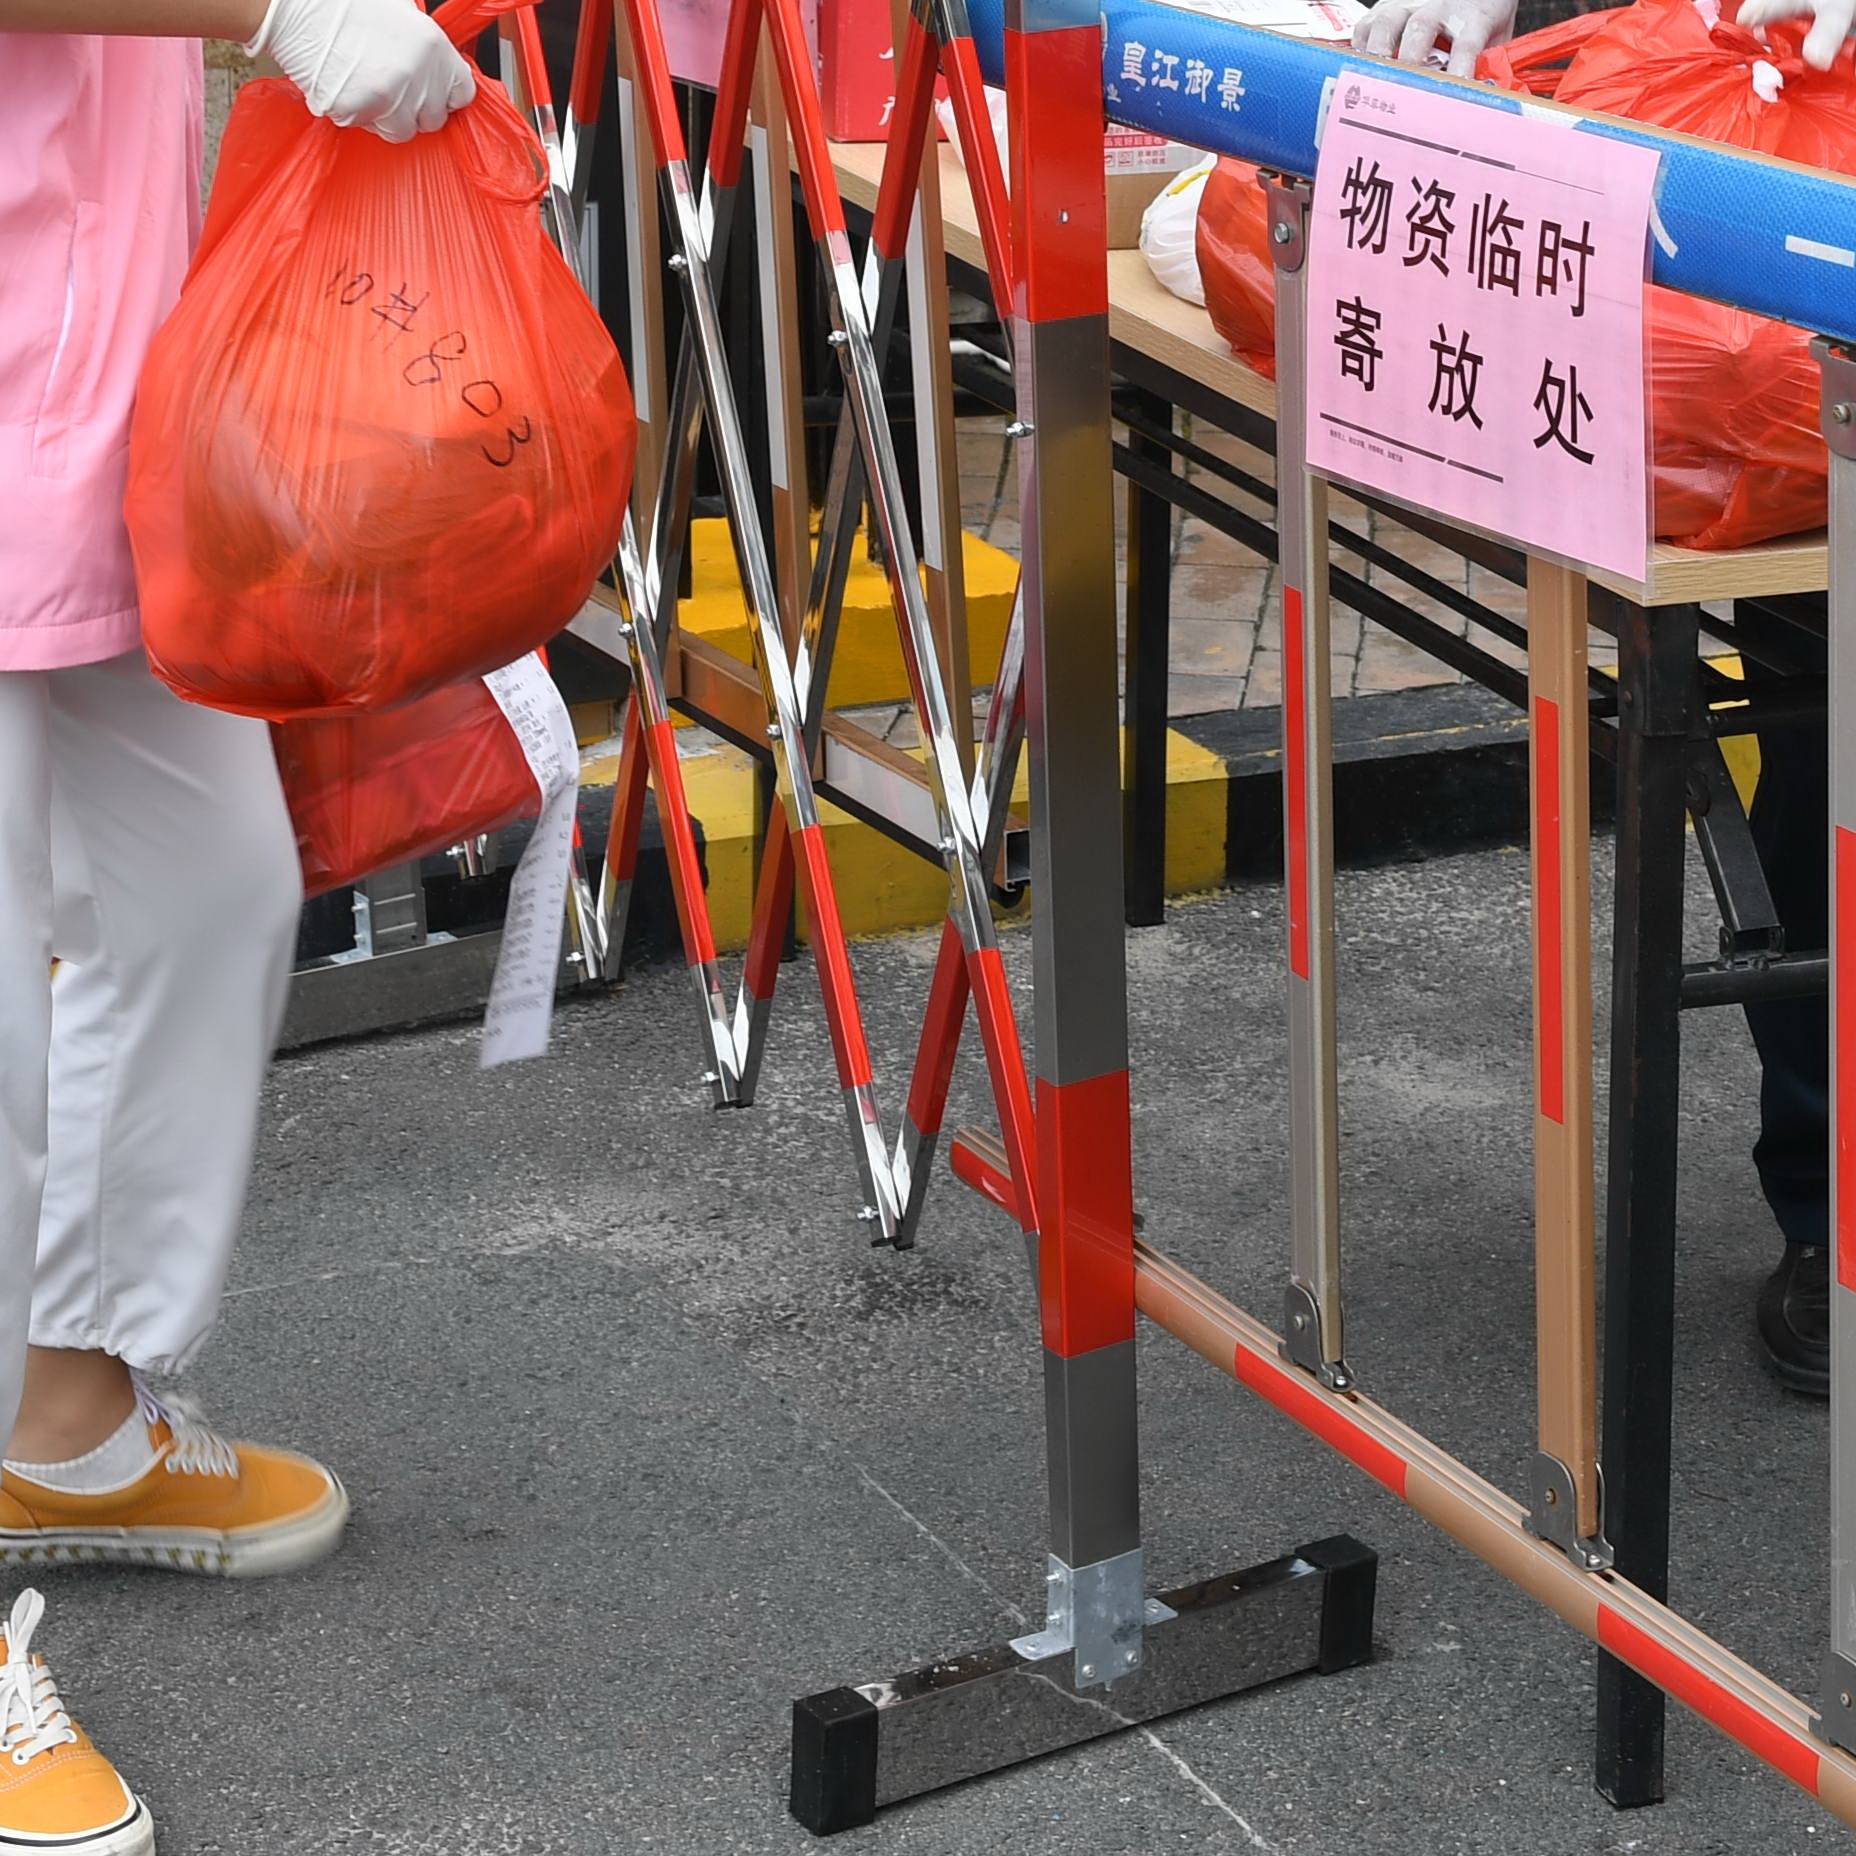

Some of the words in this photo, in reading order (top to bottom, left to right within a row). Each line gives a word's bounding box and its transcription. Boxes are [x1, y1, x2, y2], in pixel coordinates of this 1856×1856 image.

[1338, 156, 1596, 318] 物资临时
[1334, 296, 1596, 466] 寄放处
